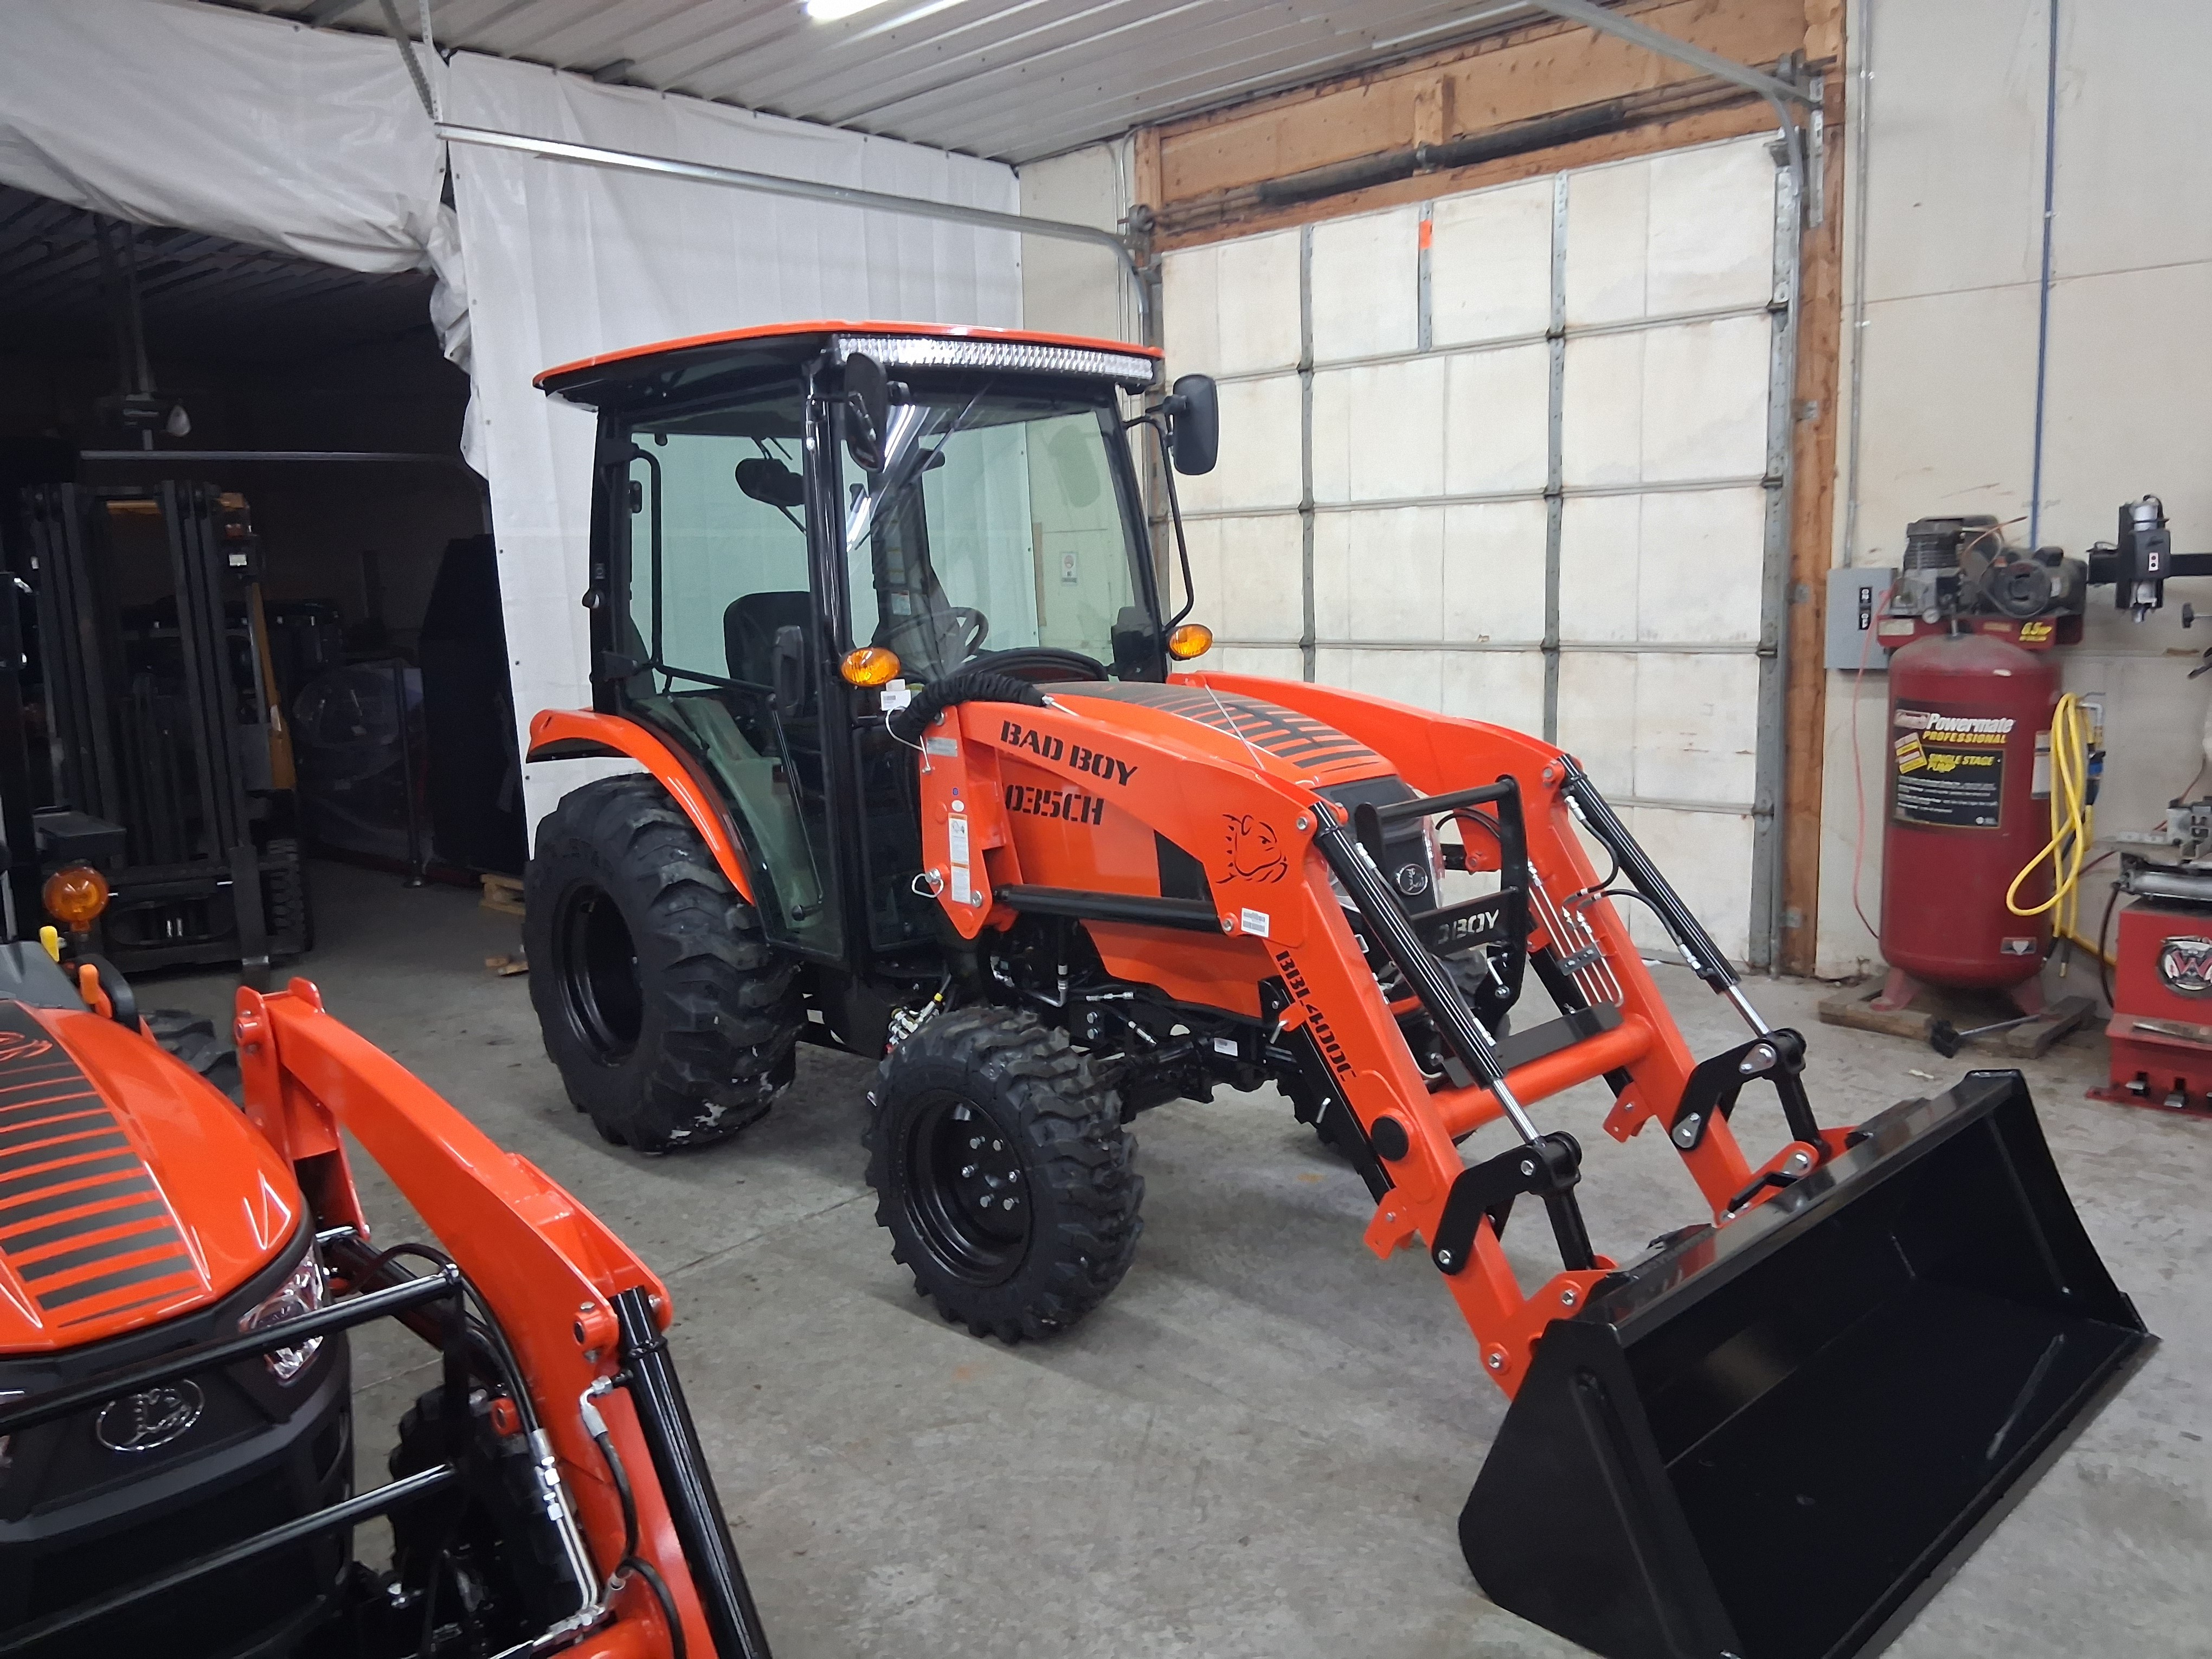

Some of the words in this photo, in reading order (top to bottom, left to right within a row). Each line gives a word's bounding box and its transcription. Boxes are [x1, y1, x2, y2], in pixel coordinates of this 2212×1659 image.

[1926, 713, 2015, 733] Powermate
[1922, 730, 2007, 743] PROFESSIONAL
[1000, 720, 1064, 762] BAD
[1069, 744, 1138, 786] BOY
[1962, 755, 1995, 766] STAGE
